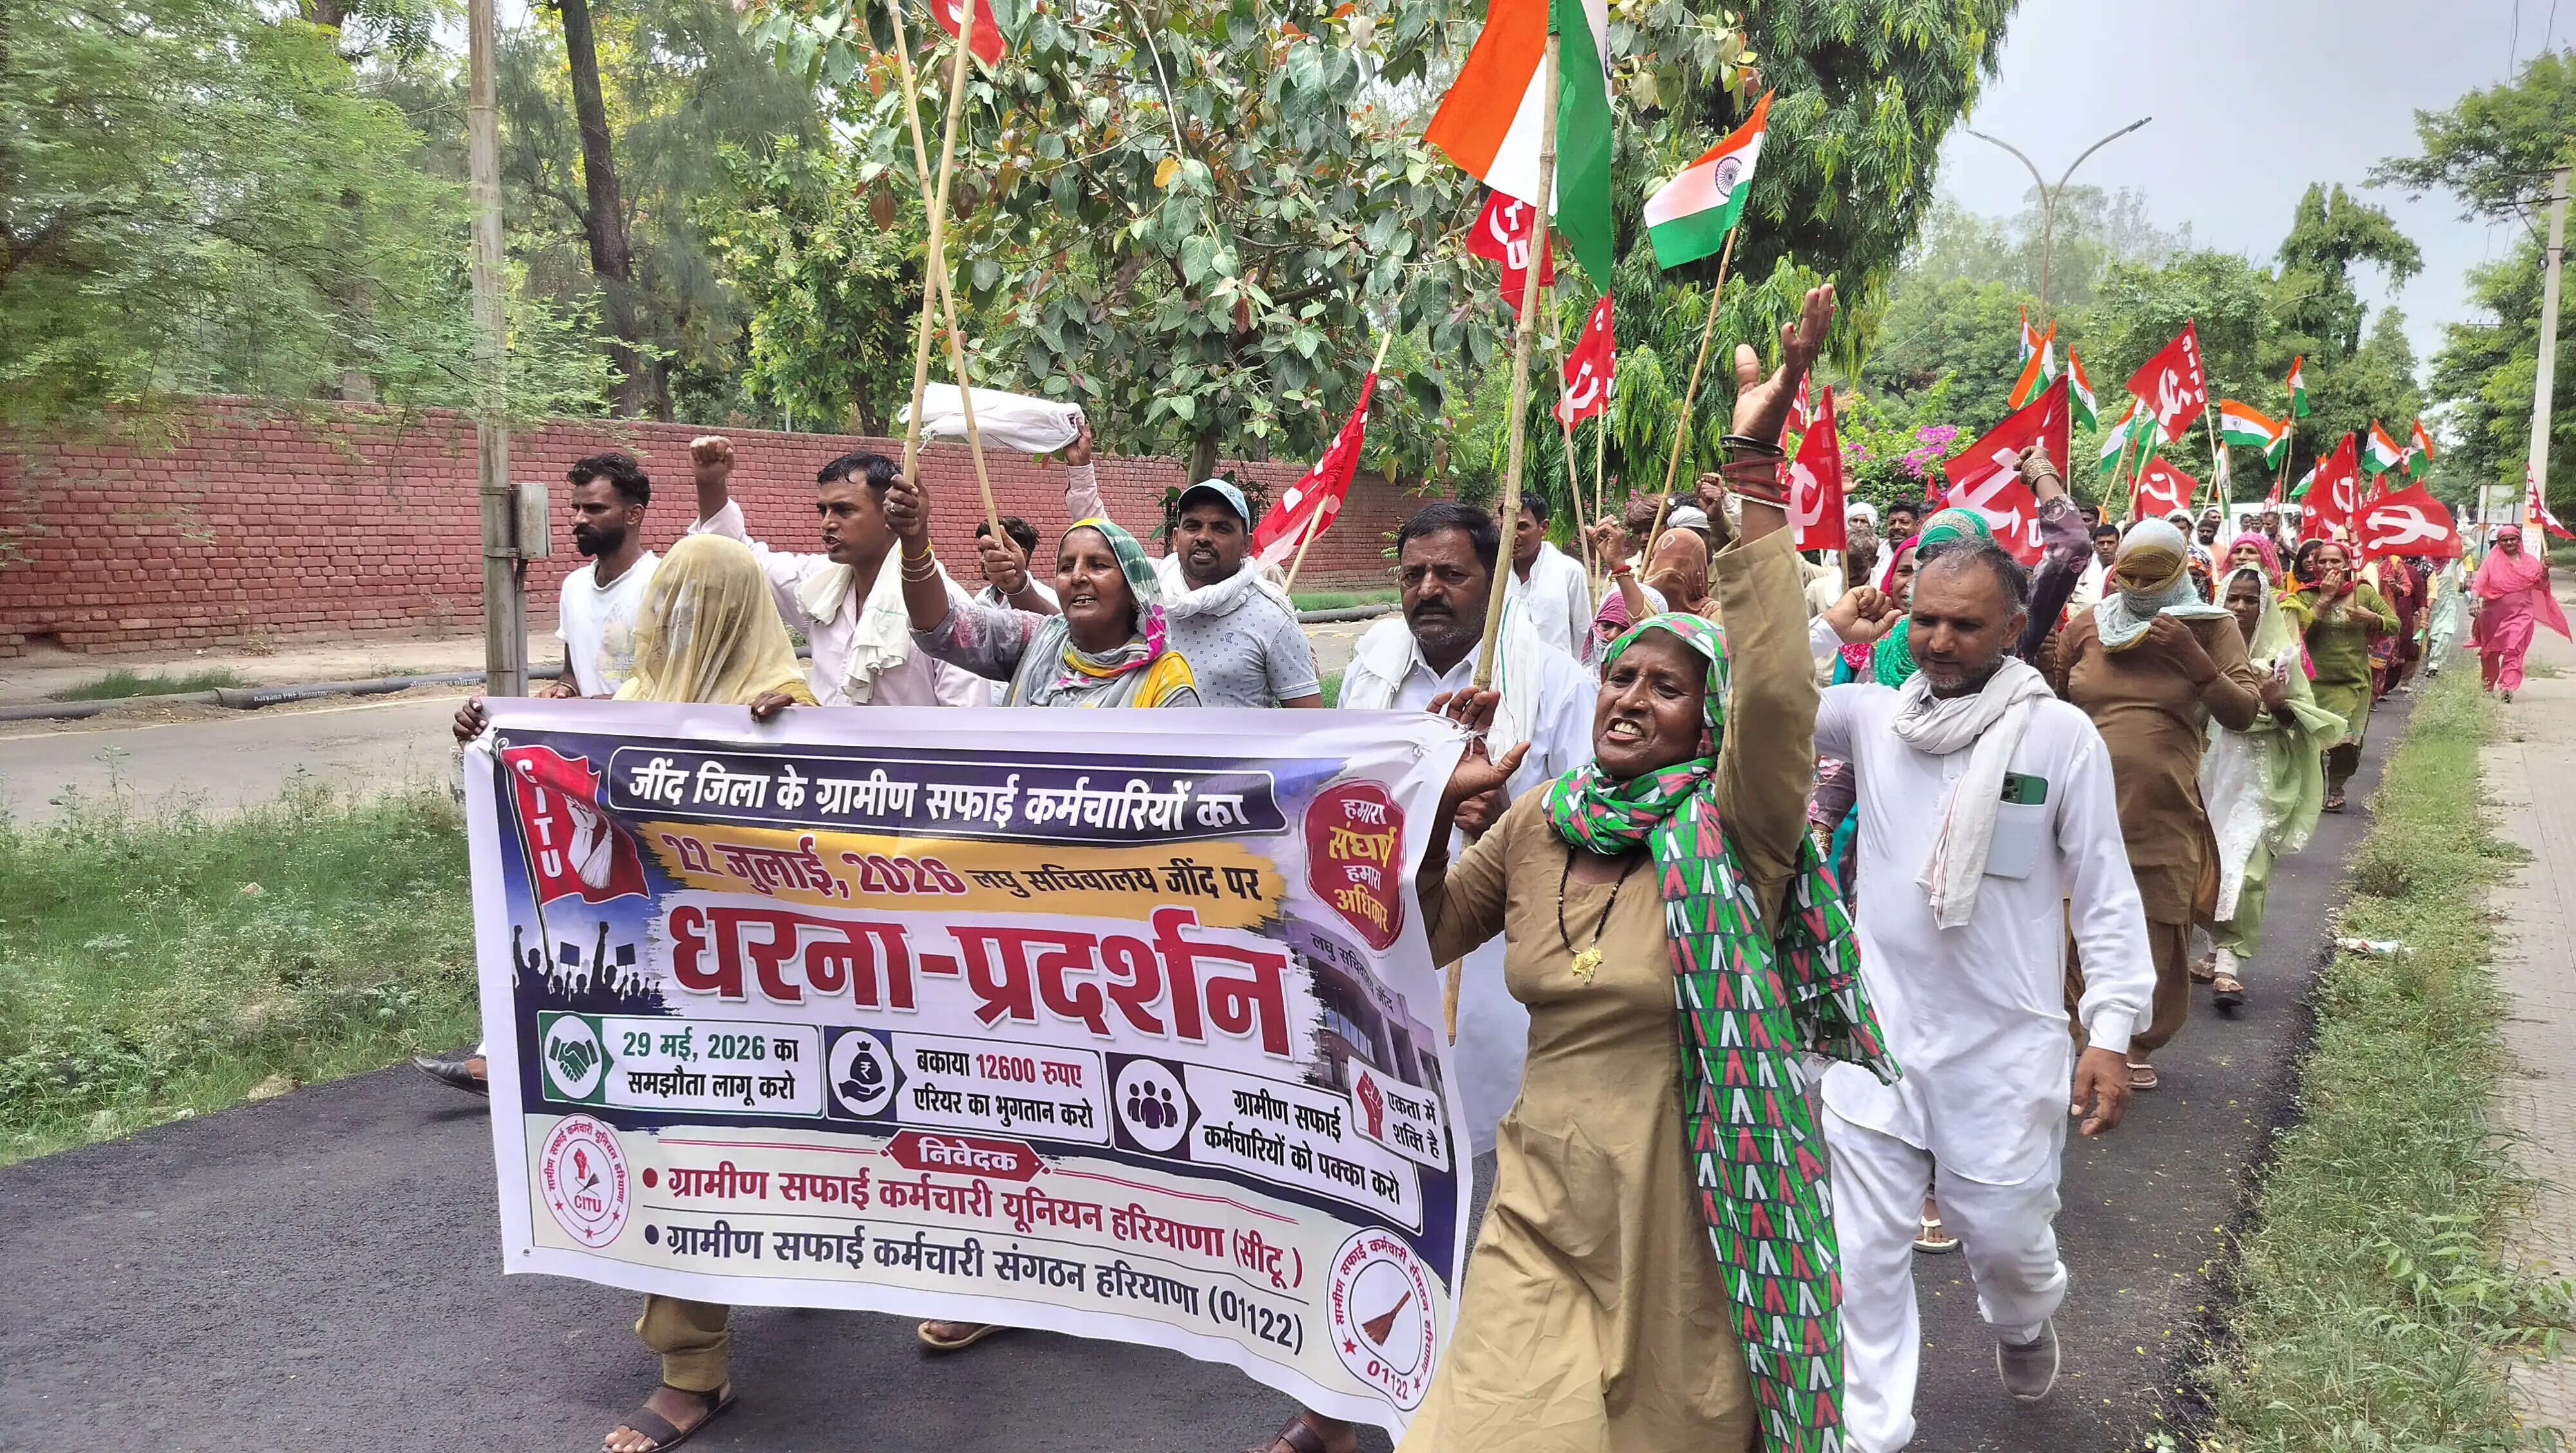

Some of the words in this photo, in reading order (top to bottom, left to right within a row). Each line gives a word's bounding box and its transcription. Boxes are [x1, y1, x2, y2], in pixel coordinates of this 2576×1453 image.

[629, 757, 690, 805] जींद
[693, 761, 771, 808] जिला
[776, 764, 808, 810] के
[815, 768, 918, 818] ग्रामीण
[925, 774, 1020, 828] सफाई
[1024, 777, 1193, 831] कर्मचारियों
[1196, 793, 1249, 828] का
[1340, 799, 1388, 825] हमारा
[516, 759, 562, 878] CITU
[659, 833, 724, 877] 22
[711, 833, 851, 900] जुलाई,
[840, 851, 967, 895] 2026
[965, 869, 1030, 898] लघु
[1019, 863, 1158, 893] सचिवालय
[1158, 858, 1218, 898] जींद
[1221, 867, 1262, 900] पर
[1329, 821, 1397, 868] संघर्ष
[1343, 865, 1381, 891] हमारा
[1334, 884, 1389, 933] अधिकार
[668, 906, 1291, 1058] धरना-प्रदर्शन
[1311, 933, 1336, 962] लघु
[1376, 985, 1394, 1014] जींद
[623, 1031, 651, 1057] 29
[660, 1026, 698, 1063] मई,
[708, 1033, 766, 1060] 2026
[773, 1038, 799, 1063] का
[915, 1049, 971, 1077] बकाया
[976, 1053, 1036, 1083] 12600
[627, 1064, 706, 1099] समझौता
[712, 1074, 755, 1106] लागू
[758, 1069, 795, 1100] करो
[913, 1082, 963, 1114] एरियर
[967, 1092, 990, 1116] का
[996, 1095, 1054, 1127] भुगतान
[1059, 1097, 1094, 1128] करो
[1386, 1090, 1421, 1121] एकता
[1422, 1098, 1437, 1126] में
[1232, 1087, 1289, 1125] ग्रामीण
[1293, 1105, 1341, 1144] सफाई
[549, 1127, 567, 1156] सफाई
[565, 1119, 594, 1135] कर्मचारी
[595, 1128, 618, 1161] यूनियन
[614, 1162, 627, 1206] हरियाणा
[918, 1135, 1018, 1172] निवेदक
[1203, 1121, 1285, 1166] कर्मचारियों
[1289, 1139, 1312, 1174] को
[1318, 1152, 1366, 1190] पक्का
[1370, 1170, 1401, 1205] करो
[1392, 1122, 1425, 1154] शक्ति
[1428, 1128, 1440, 1159] है
[574, 1195, 602, 1213] CITU
[668, 1161, 770, 1201] ग्रामीण
[777, 1166, 871, 1211] सफाई
[878, 1172, 994, 1218] कर्मचारी
[1001, 1186, 1103, 1233] यूनियन
[1110, 1202, 1226, 1258] हरियाणा
[1340, 1239, 1367, 1276] सफाई
[1368, 1235, 1408, 1265] कर्मचारी
[667, 1219, 764, 1260] ग्रामीण
[772, 1224, 866, 1269] सफाई
[873, 1230, 985, 1278] कर्मचारी
[992, 1243, 1086, 1292] संगठन
[1095, 1258, 1199, 1316] हरियाणा
[1208, 1285, 1304, 1356] (01122)
[1367, 1360, 1408, 1401] 01122
